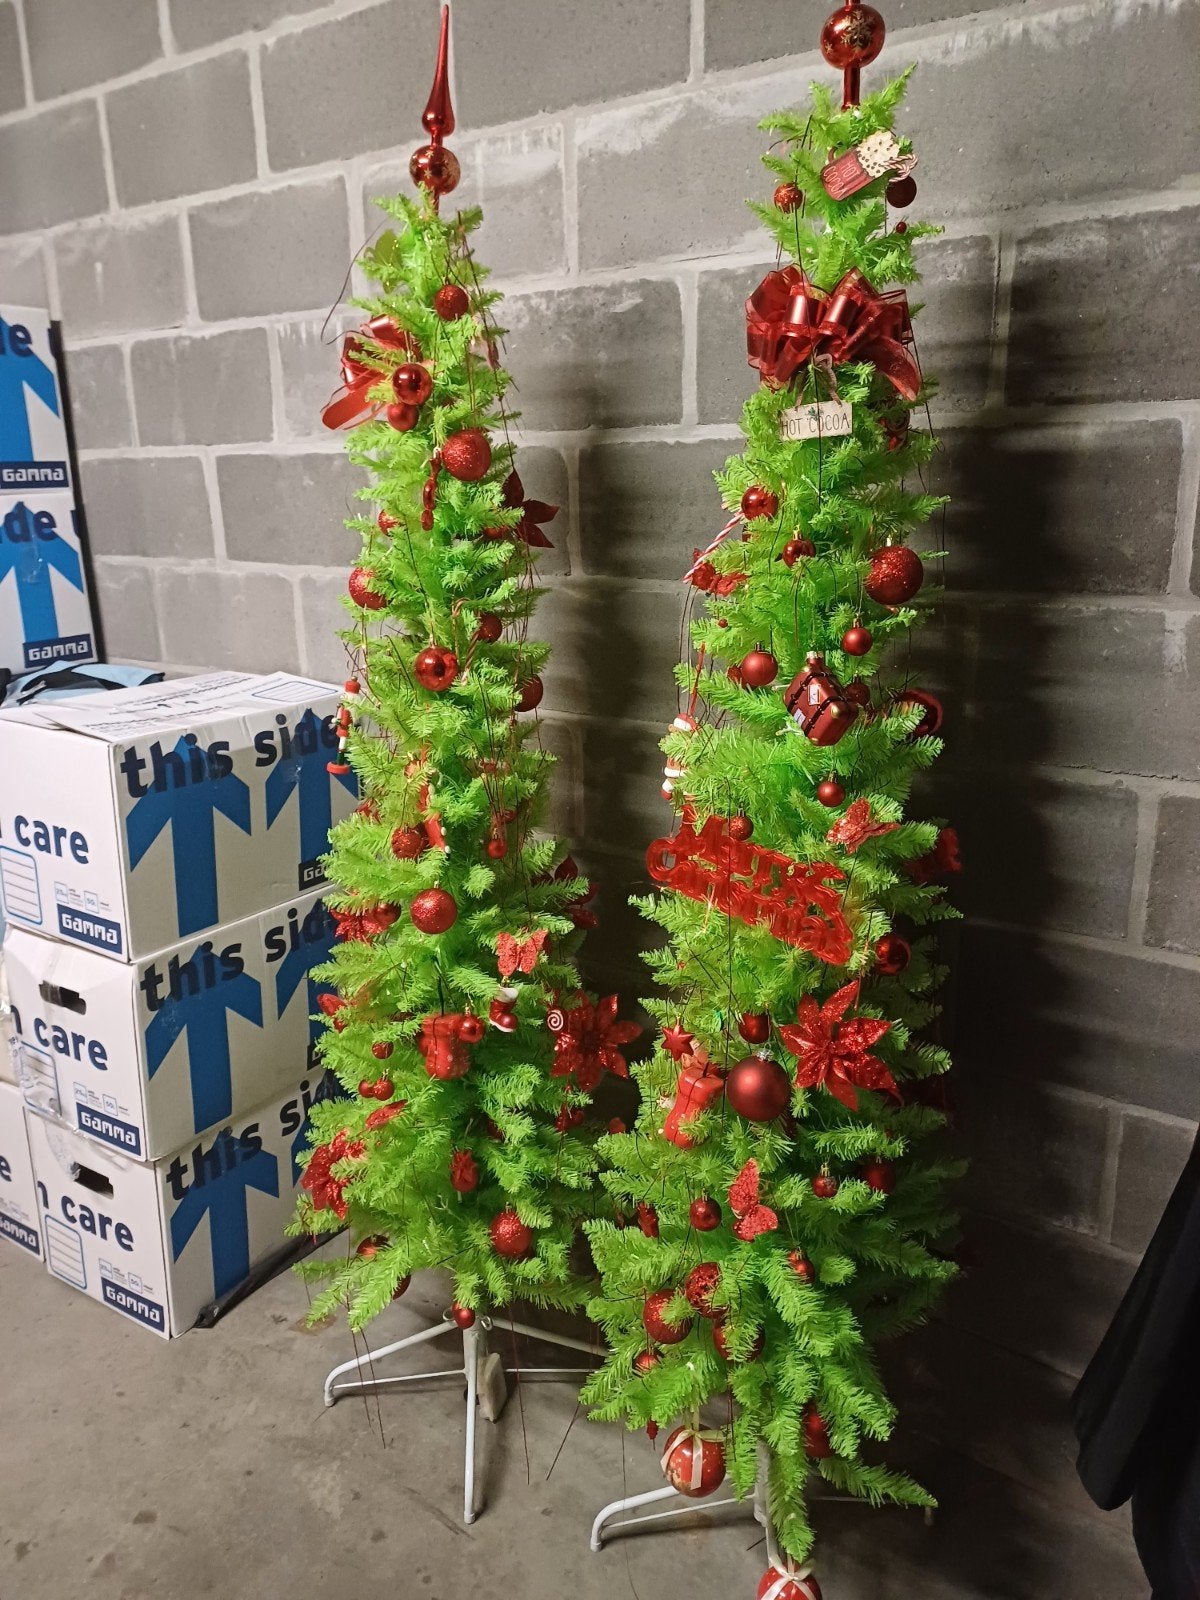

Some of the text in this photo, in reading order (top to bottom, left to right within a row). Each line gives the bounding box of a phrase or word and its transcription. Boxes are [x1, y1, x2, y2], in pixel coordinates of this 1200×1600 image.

[823, 165, 848, 199] COCOA
[839, 160, 861, 182] HOT
[780, 412, 850, 437] HOT COCOA
[120, 733, 233, 798] this
[254, 708, 339, 767] side
[14, 814, 89, 864] care
[140, 898, 328, 1012] this sid
[33, 1017, 108, 1071] care
[166, 1126, 263, 1200] this
[61, 1195, 134, 1252] care
